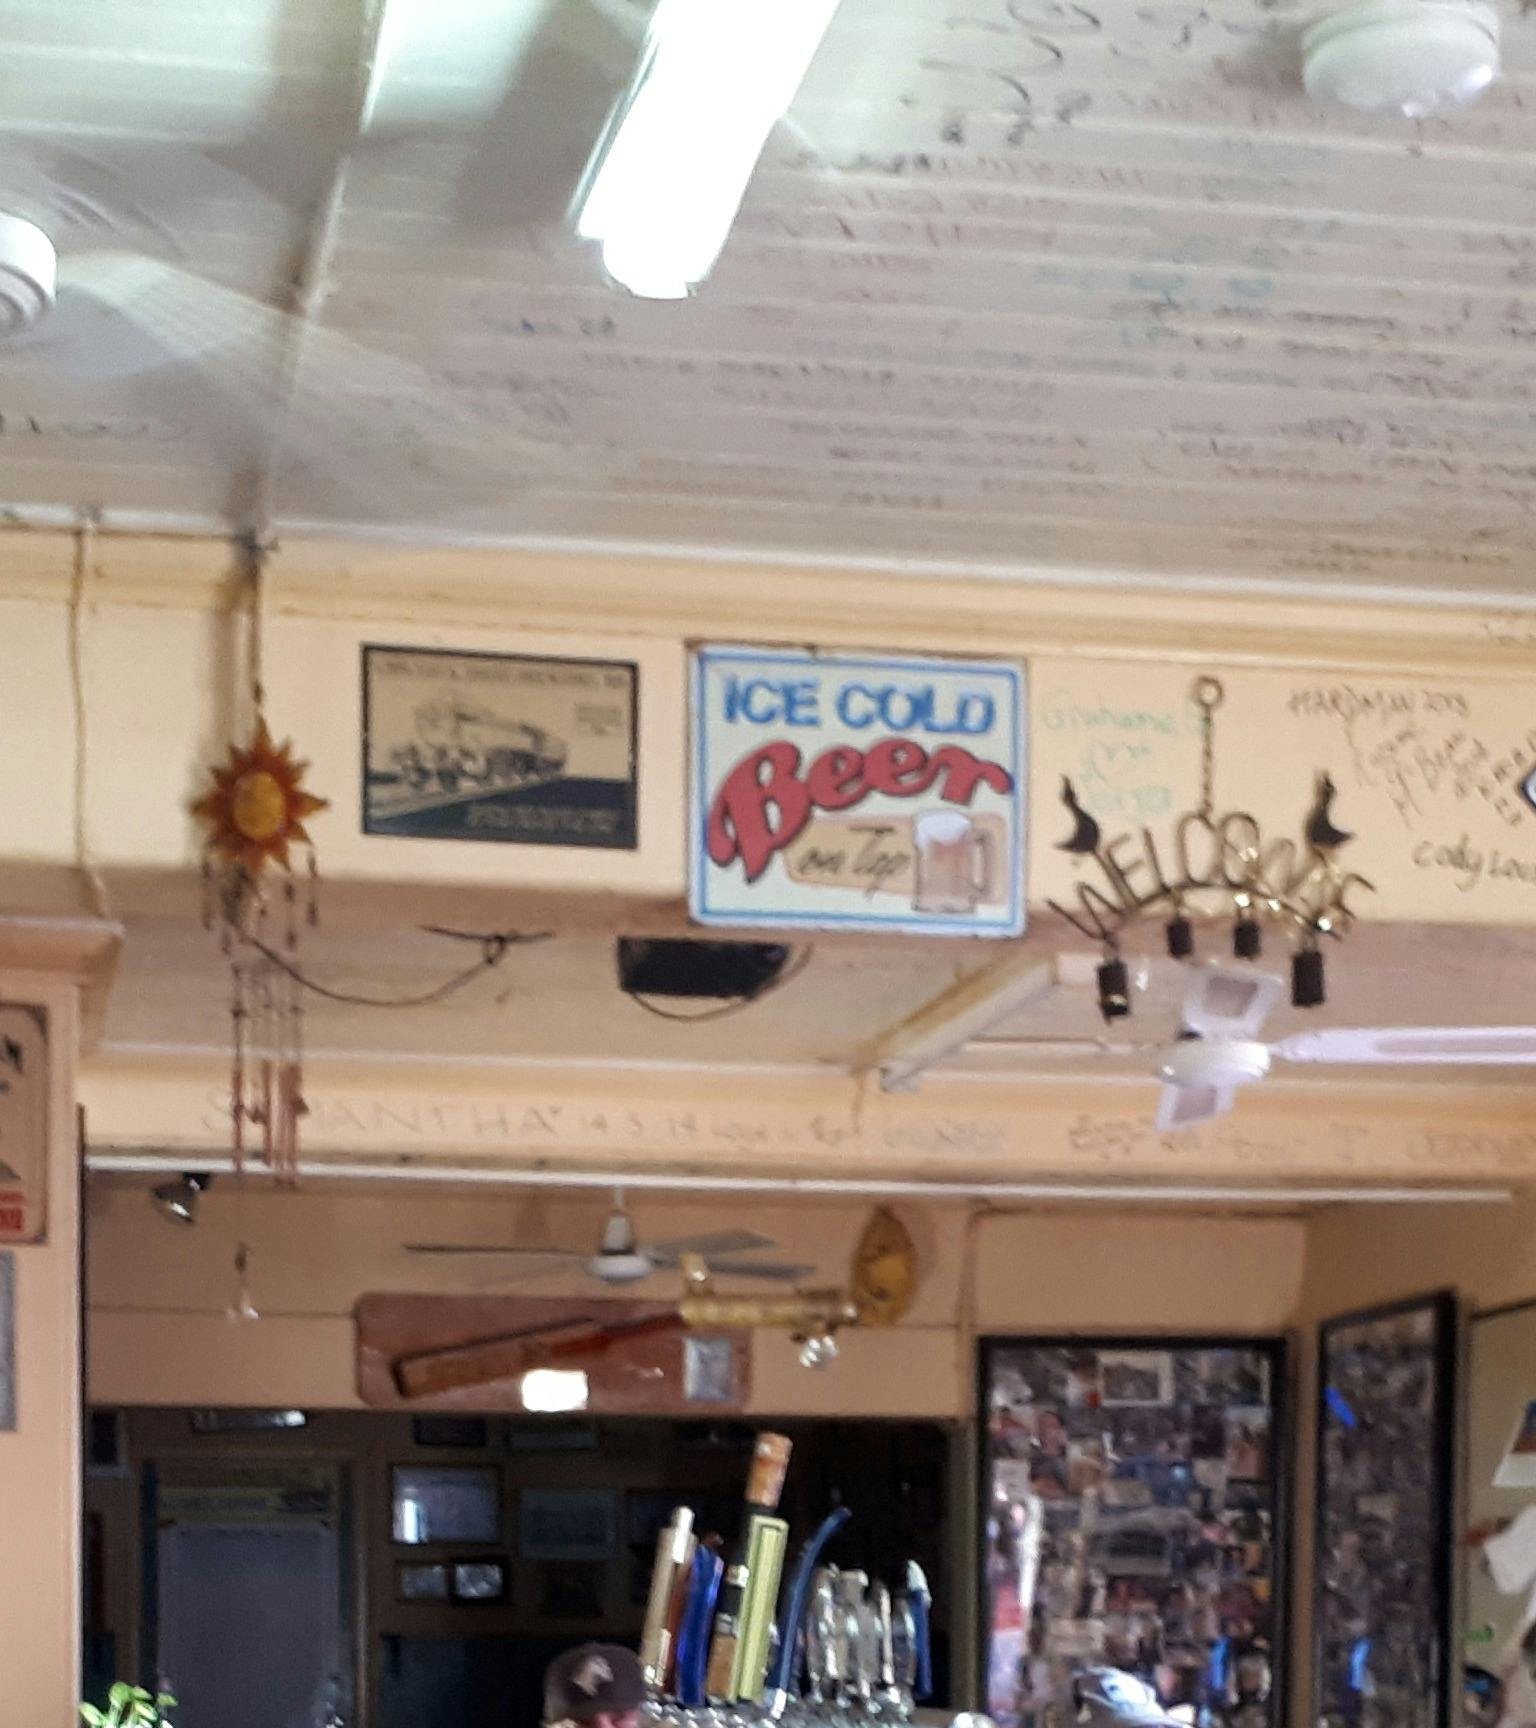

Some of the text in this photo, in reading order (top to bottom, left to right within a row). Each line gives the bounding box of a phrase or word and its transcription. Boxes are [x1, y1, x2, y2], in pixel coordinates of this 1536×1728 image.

[724, 675, 821, 729] ICE
[835, 680, 998, 735] COLD
[706, 736, 1012, 884] Beer
